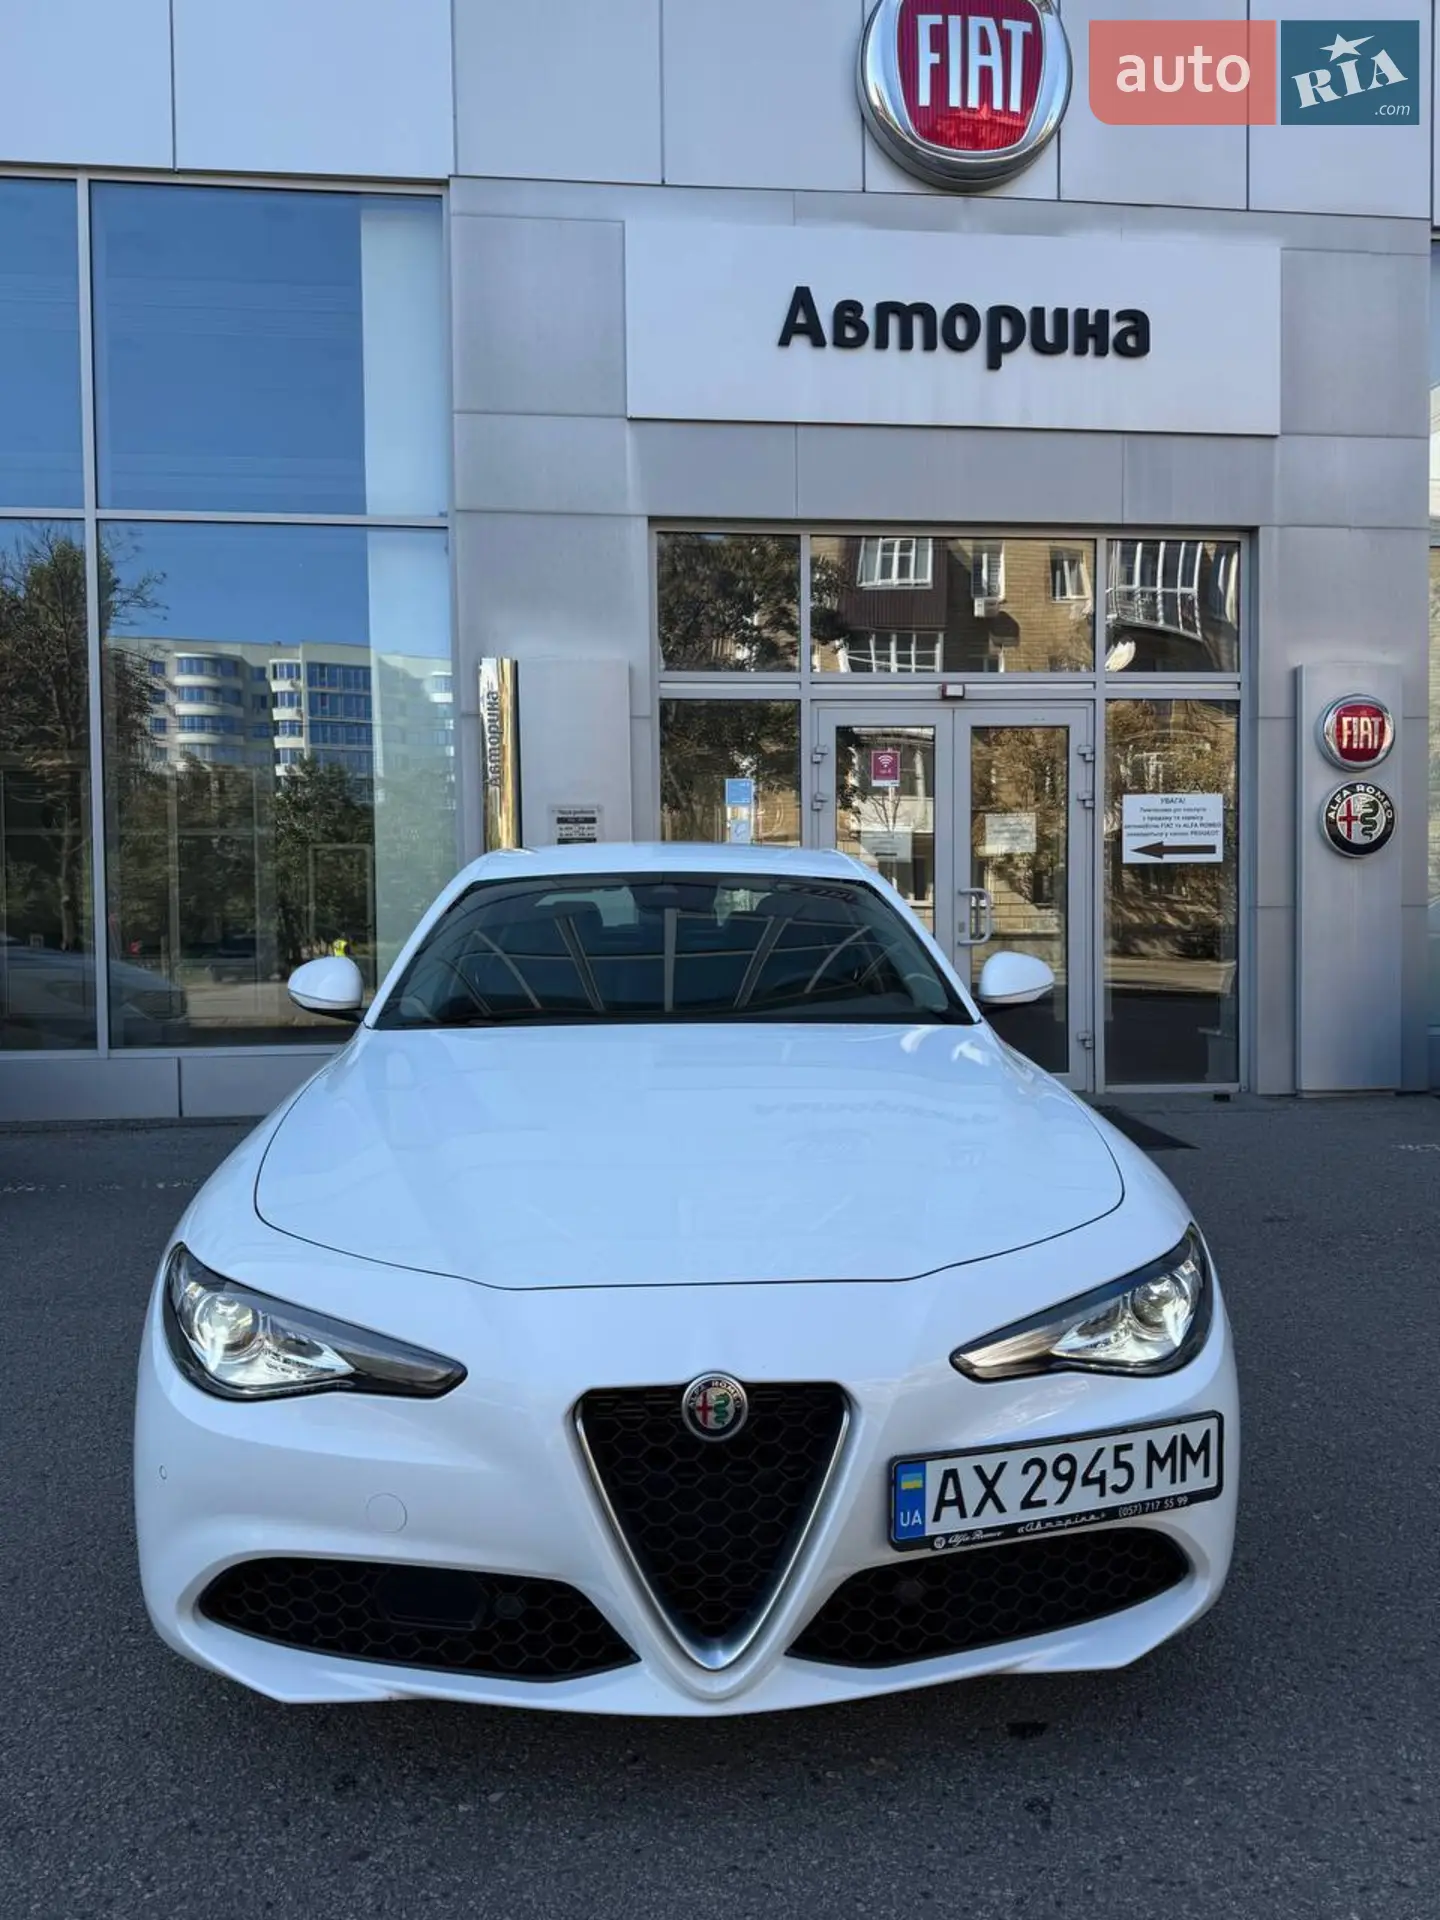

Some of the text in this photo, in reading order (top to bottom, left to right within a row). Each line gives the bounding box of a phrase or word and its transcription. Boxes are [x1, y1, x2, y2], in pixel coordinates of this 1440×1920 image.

[917, 14, 1032, 112] FIAT
[778, 286, 1151, 370] Авторина
[485, 690, 503, 788] Авторина
[1341, 716, 1383, 750] FIAT
[1327, 784, 1394, 821] ALFA ROMEO
[932, 1428, 1211, 1523] AX 2945 MM
[900, 1508, 922, 1528] UA
[1118, 1495, 1189, 1518] (057) 717 55 99
